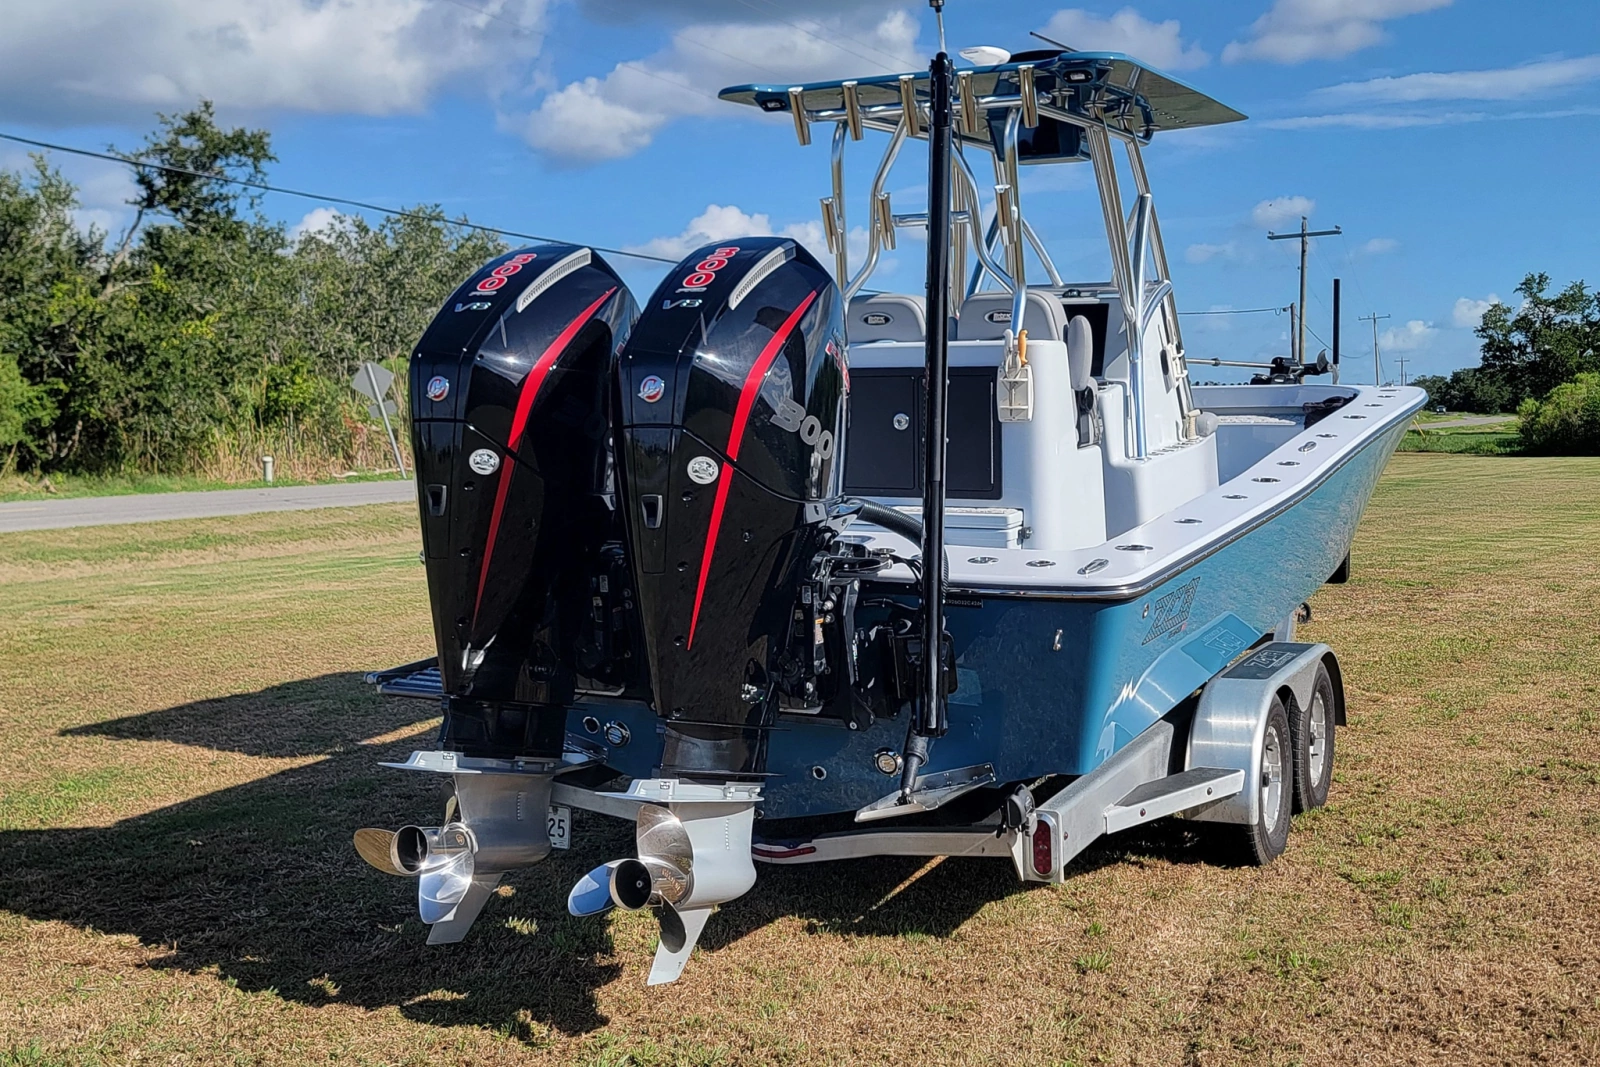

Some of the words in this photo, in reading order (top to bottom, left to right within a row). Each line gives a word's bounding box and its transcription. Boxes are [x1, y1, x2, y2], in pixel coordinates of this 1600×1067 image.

[476, 253, 538, 291] 300
[682, 247, 740, 288] 300
[769, 398, 833, 460] 300
